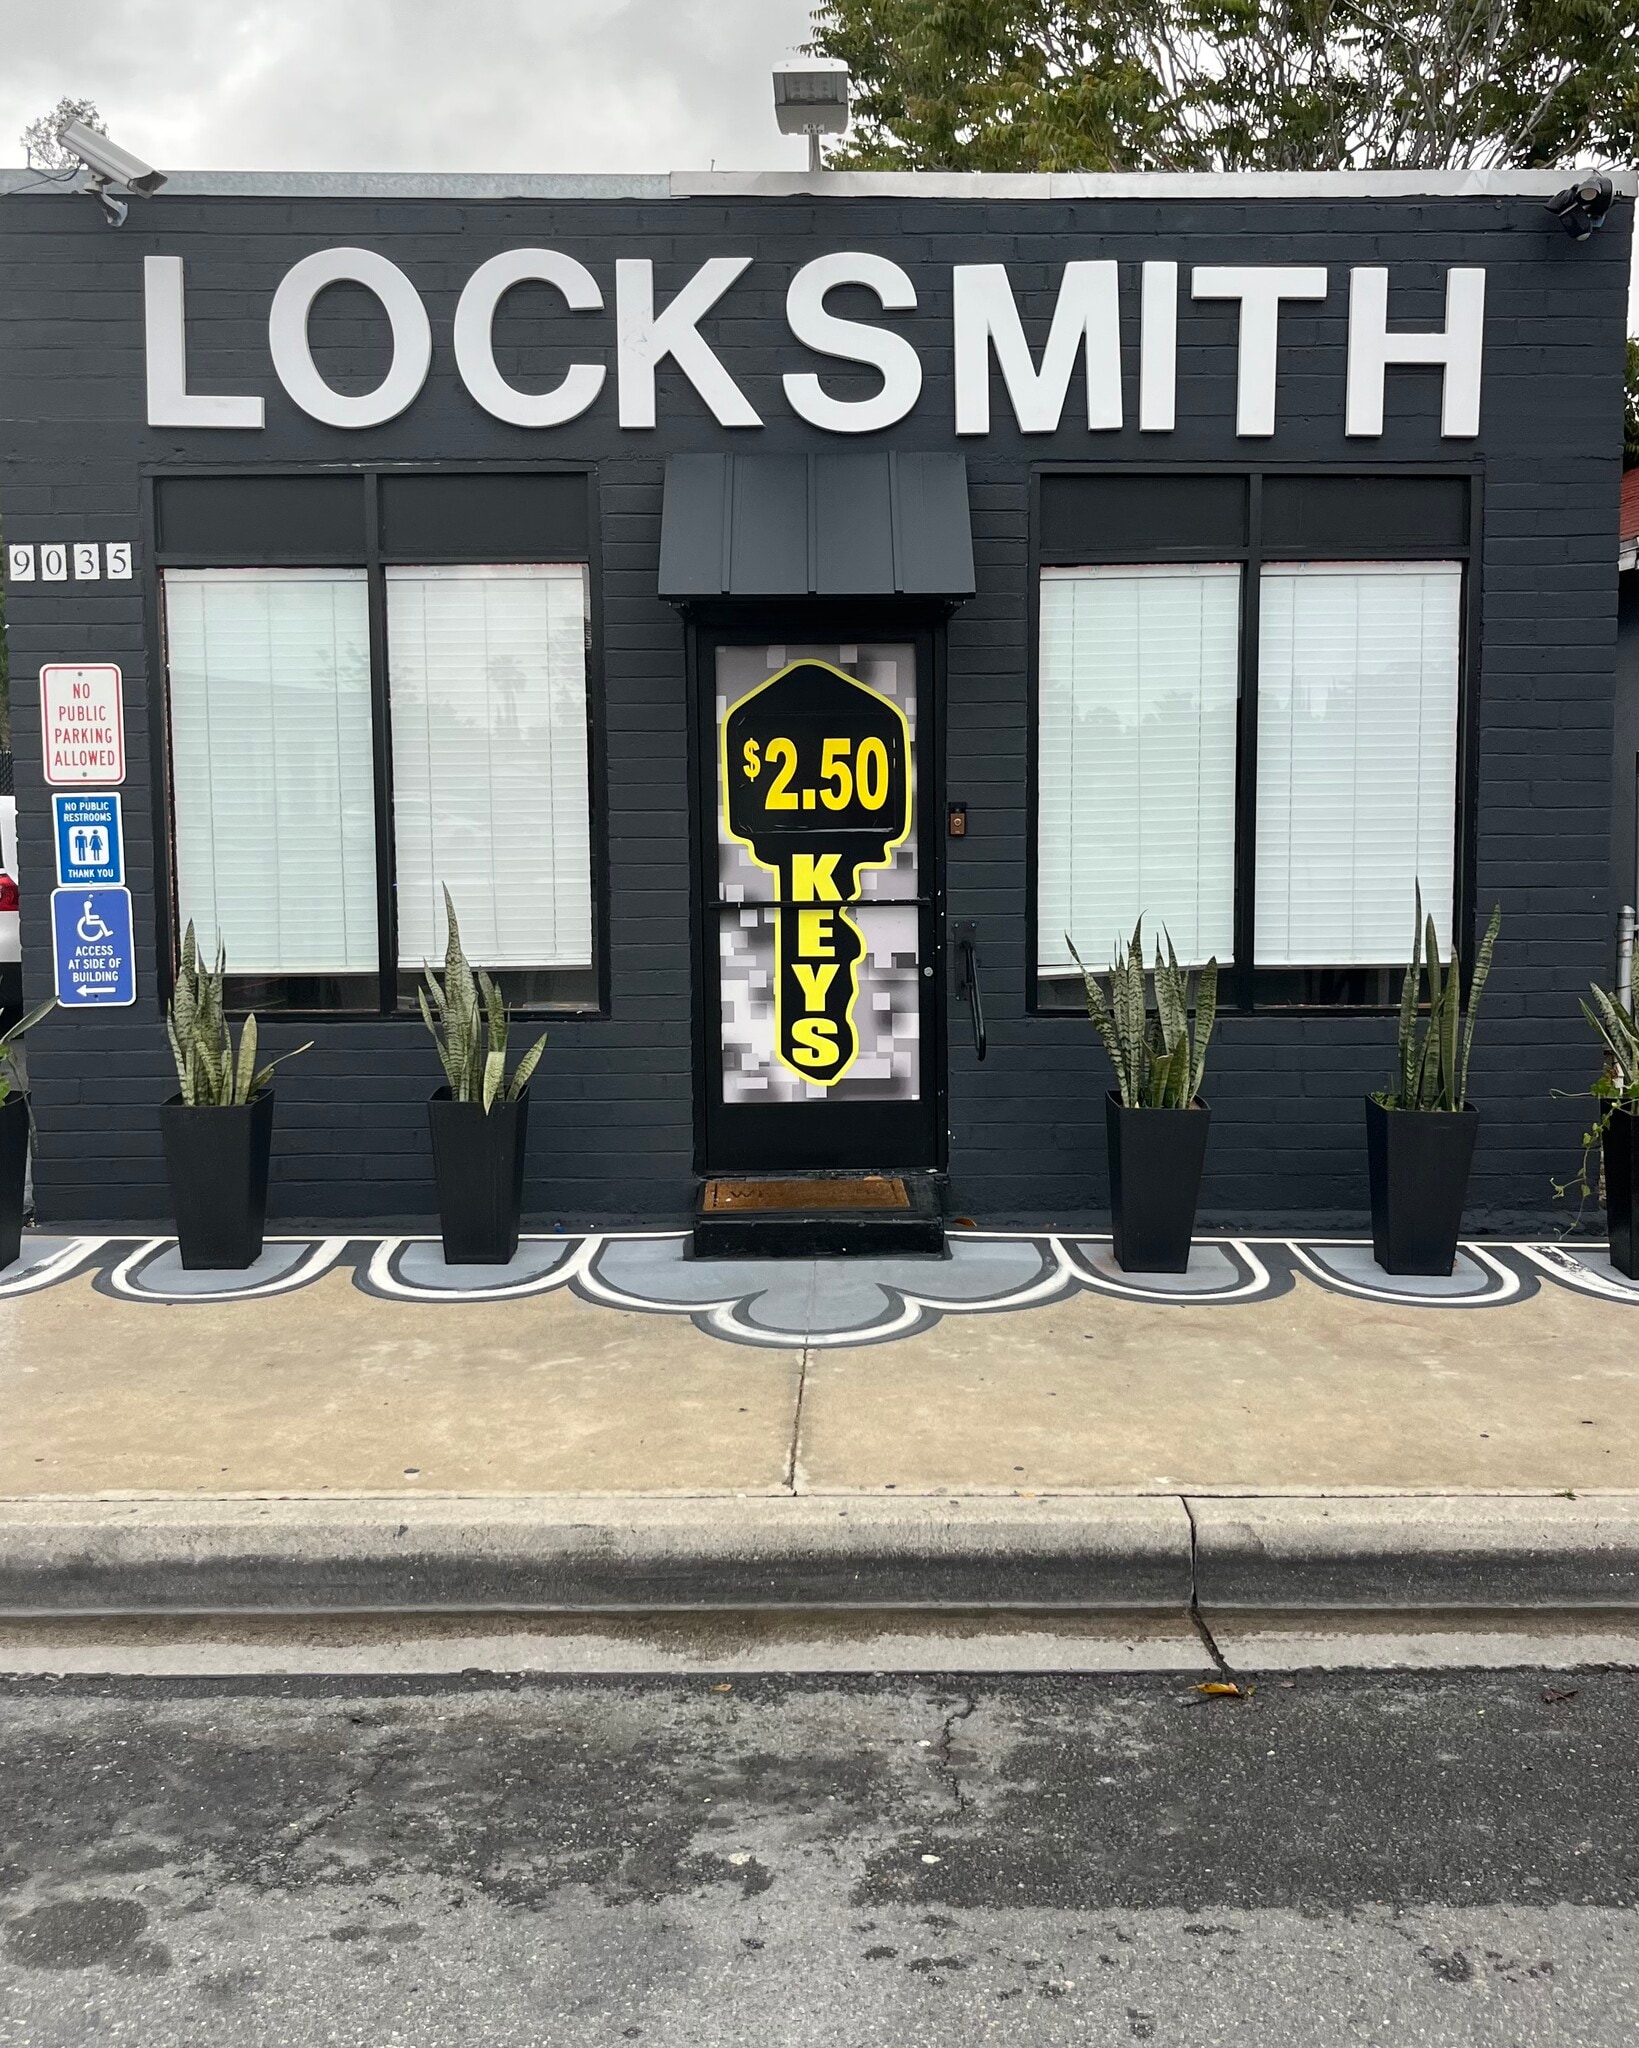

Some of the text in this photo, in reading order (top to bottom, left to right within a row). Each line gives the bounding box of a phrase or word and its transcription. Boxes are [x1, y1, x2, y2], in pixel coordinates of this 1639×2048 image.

[143, 246, 1487, 438] LOCKSMITH
[13, 549, 126, 575] 9035
[72, 683, 91, 699] NO
[58, 705, 107, 722] PUBLIC
[54, 727, 113, 744] PARKING
[54, 750, 116, 767] ALLOWED
[743, 736, 889, 811] $2.50
[64, 801, 109, 811] NO PUBLIC
[63, 812, 112, 822] RESTROOMS
[67, 868, 114, 878] THANK YOU
[75, 945, 114, 957] ACCESS
[67, 957, 122, 970] AT SIDE OF
[791, 854, 842, 1067] KEYS
[72, 970, 119, 983] BUILDING
